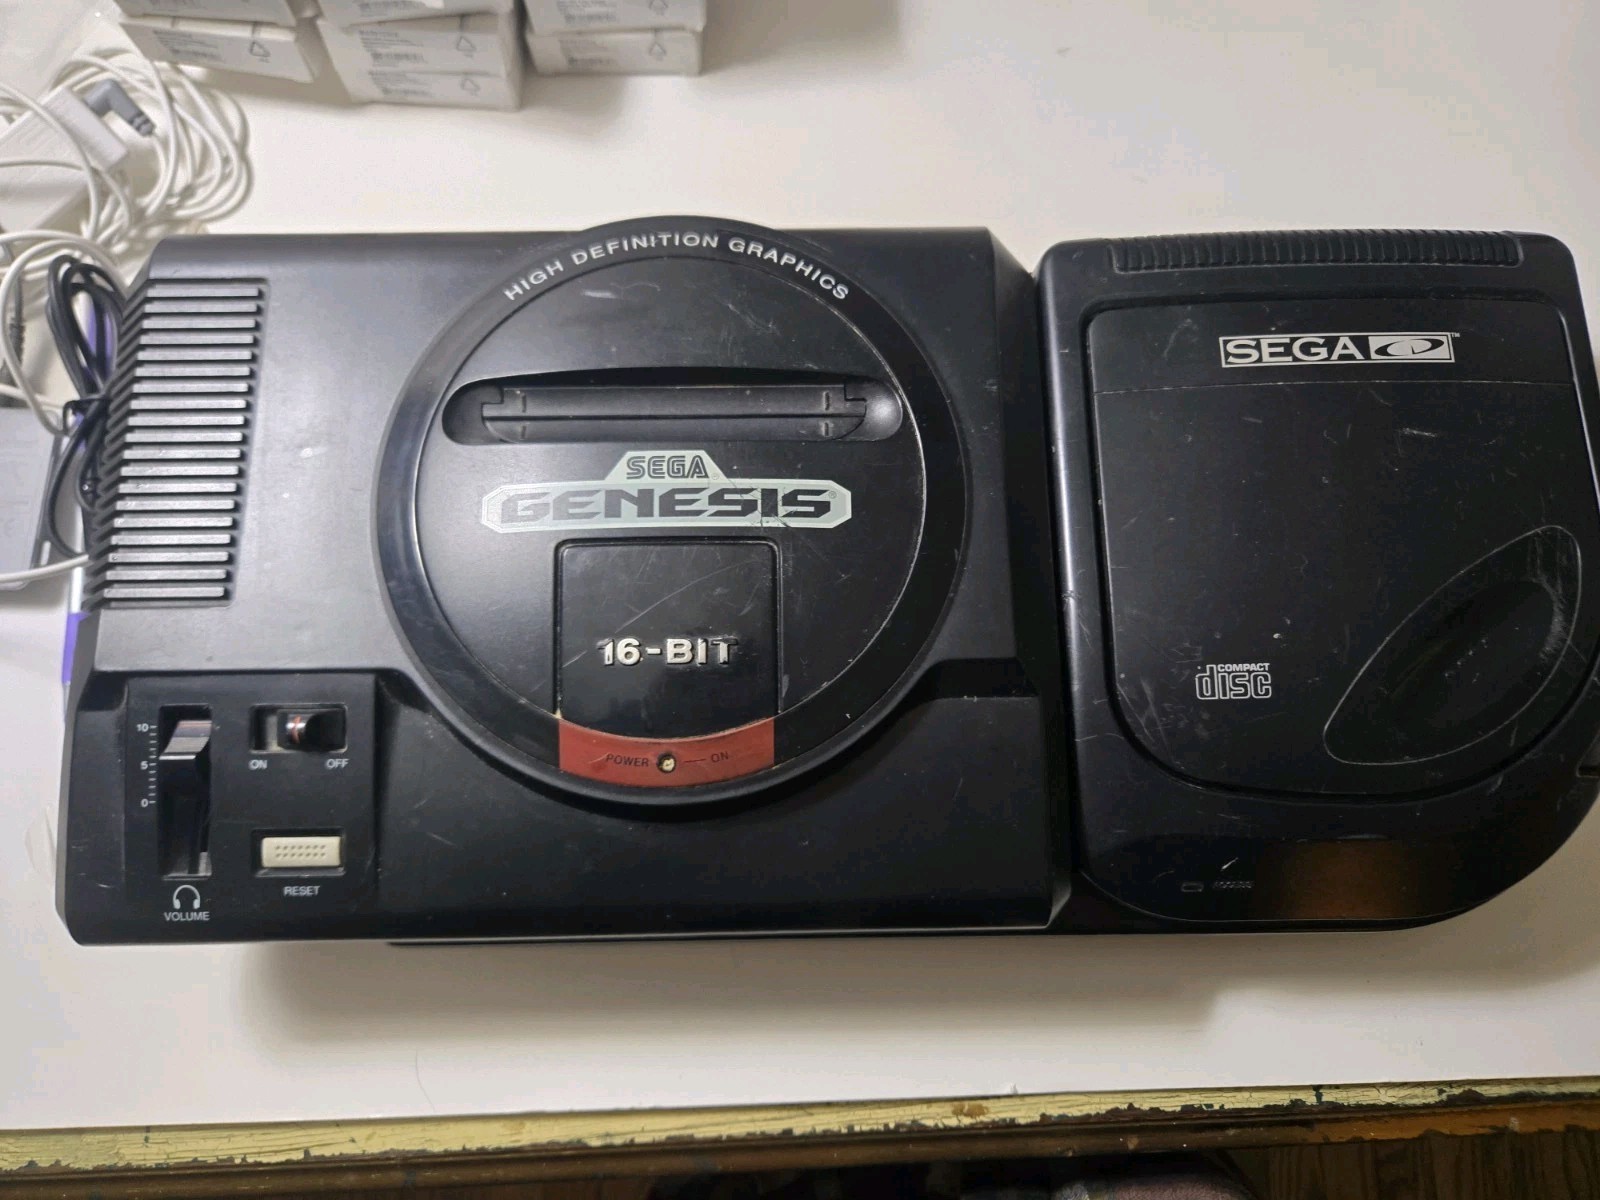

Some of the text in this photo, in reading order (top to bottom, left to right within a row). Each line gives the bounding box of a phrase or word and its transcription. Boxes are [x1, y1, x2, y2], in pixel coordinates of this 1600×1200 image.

[503, 231, 850, 300] HIGH DEFINITION GRAPHICS
[1225, 336, 1365, 364] SEGA
[626, 454, 710, 479] SEGA
[500, 487, 832, 524] GENESIS
[598, 637, 738, 667] 16-BIT
[1217, 663, 1270, 672] COMPACT
[1195, 664, 1272, 700] disc
[136, 722, 149, 732] 10
[140, 760, 149, 770] 5
[250, 759, 267, 770] ON
[326, 758, 349, 769] OFF
[606, 751, 729, 767] POWER ON
[283, 886, 320, 896] RESET
[164, 911, 210, 922] VOLUME
